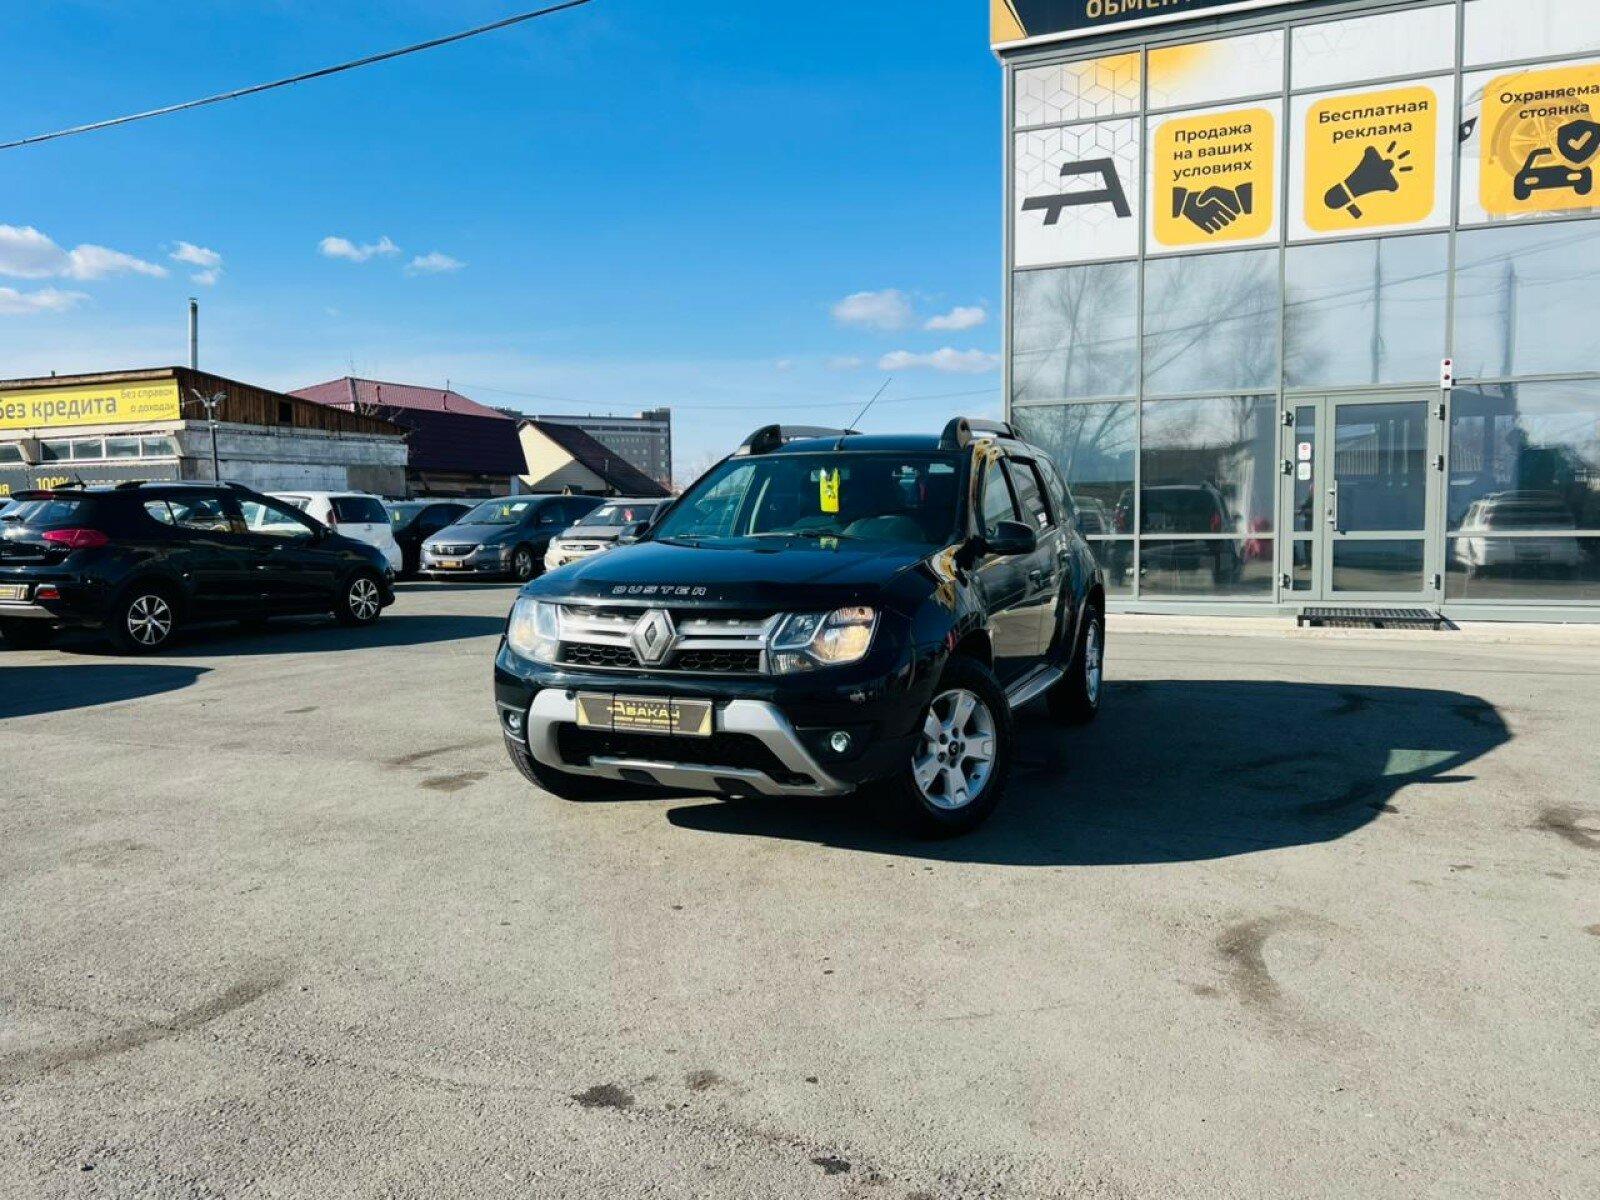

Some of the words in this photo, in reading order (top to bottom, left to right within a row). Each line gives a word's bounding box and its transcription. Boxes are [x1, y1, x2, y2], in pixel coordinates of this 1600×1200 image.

[1085, 0, 1179, 18] ОБМ
[1499, 84, 1600, 104] Охраняема
[1318, 100, 1429, 124] Бесплатная
[1519, 103, 1590, 120] стоянка
[1174, 123, 1252, 144] Продажа
[1332, 121, 1413, 143] реклама
[1173, 149, 1193, 161] на
[1198, 141, 1253, 158] ваших
[1173, 160, 1253, 182] условиях
[31, 396, 117, 422] кредита
[612, 585, 707, 596] DUSTER
